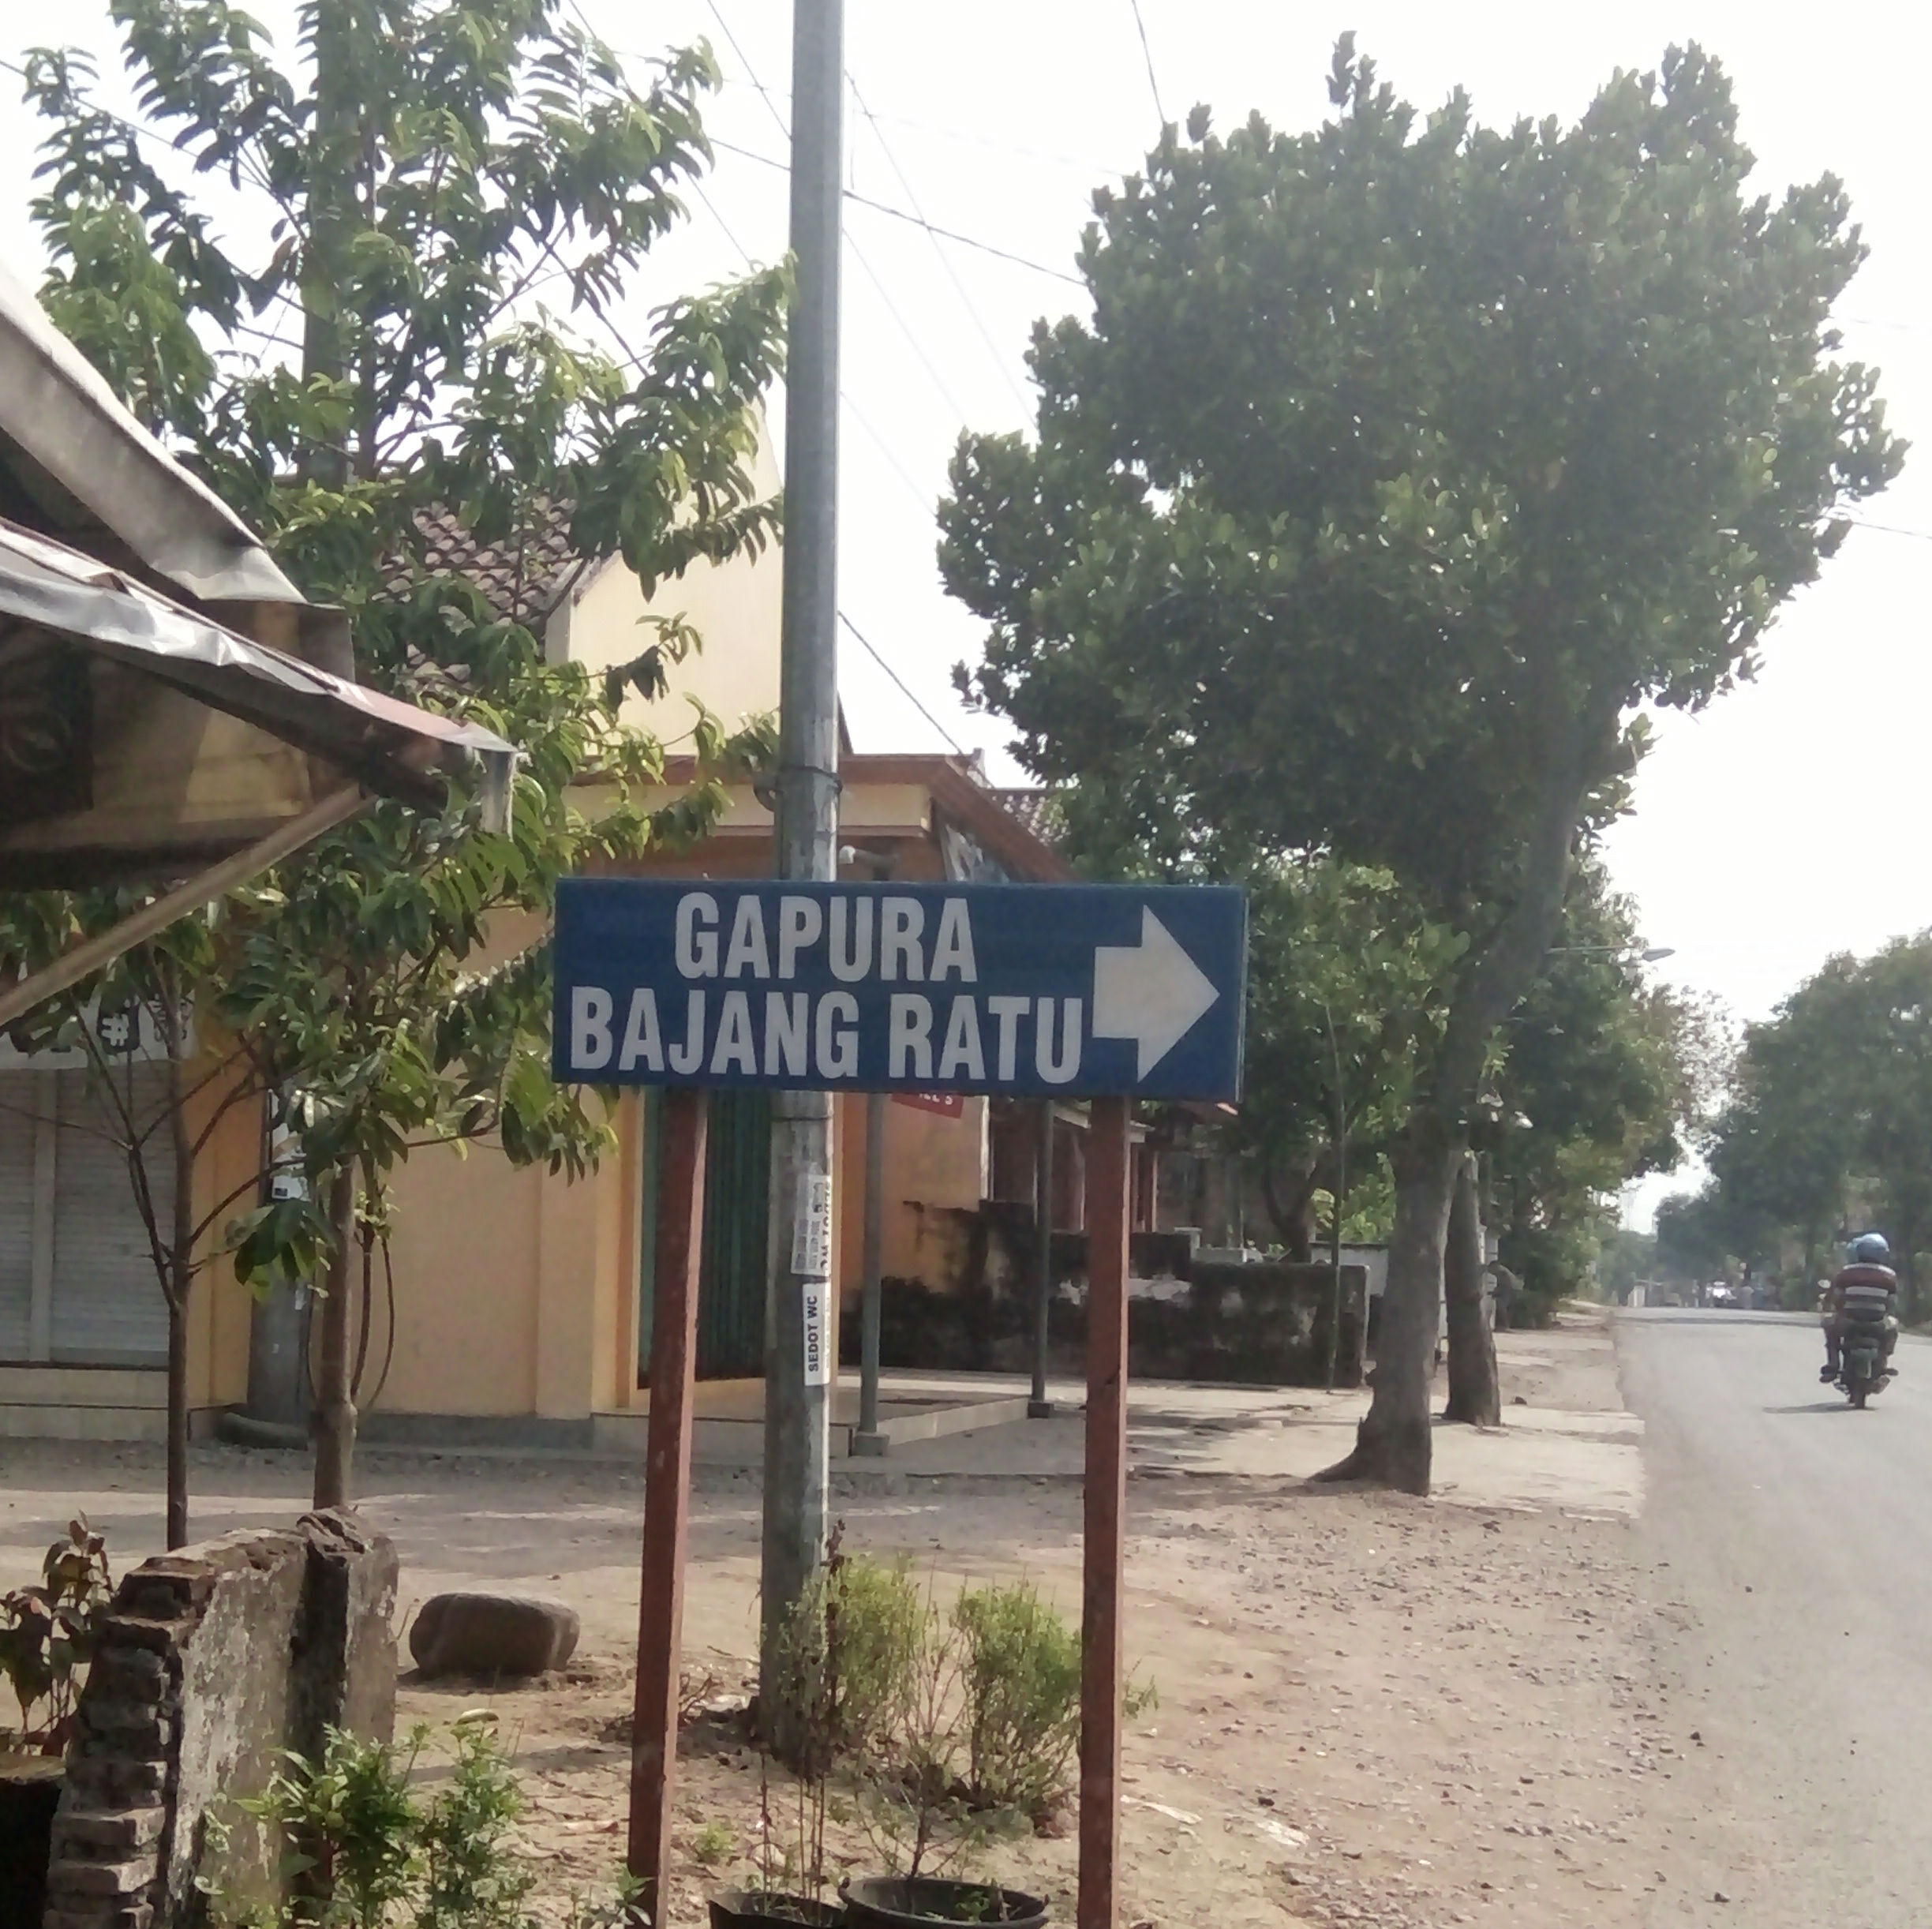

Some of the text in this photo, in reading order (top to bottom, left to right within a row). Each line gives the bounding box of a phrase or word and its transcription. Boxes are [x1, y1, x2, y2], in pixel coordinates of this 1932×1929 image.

[676, 892, 978, 983] GAPURA
[571, 986, 1082, 1084] BAJANG RATU
[807, 1295, 819, 1373] SEDOT WC
